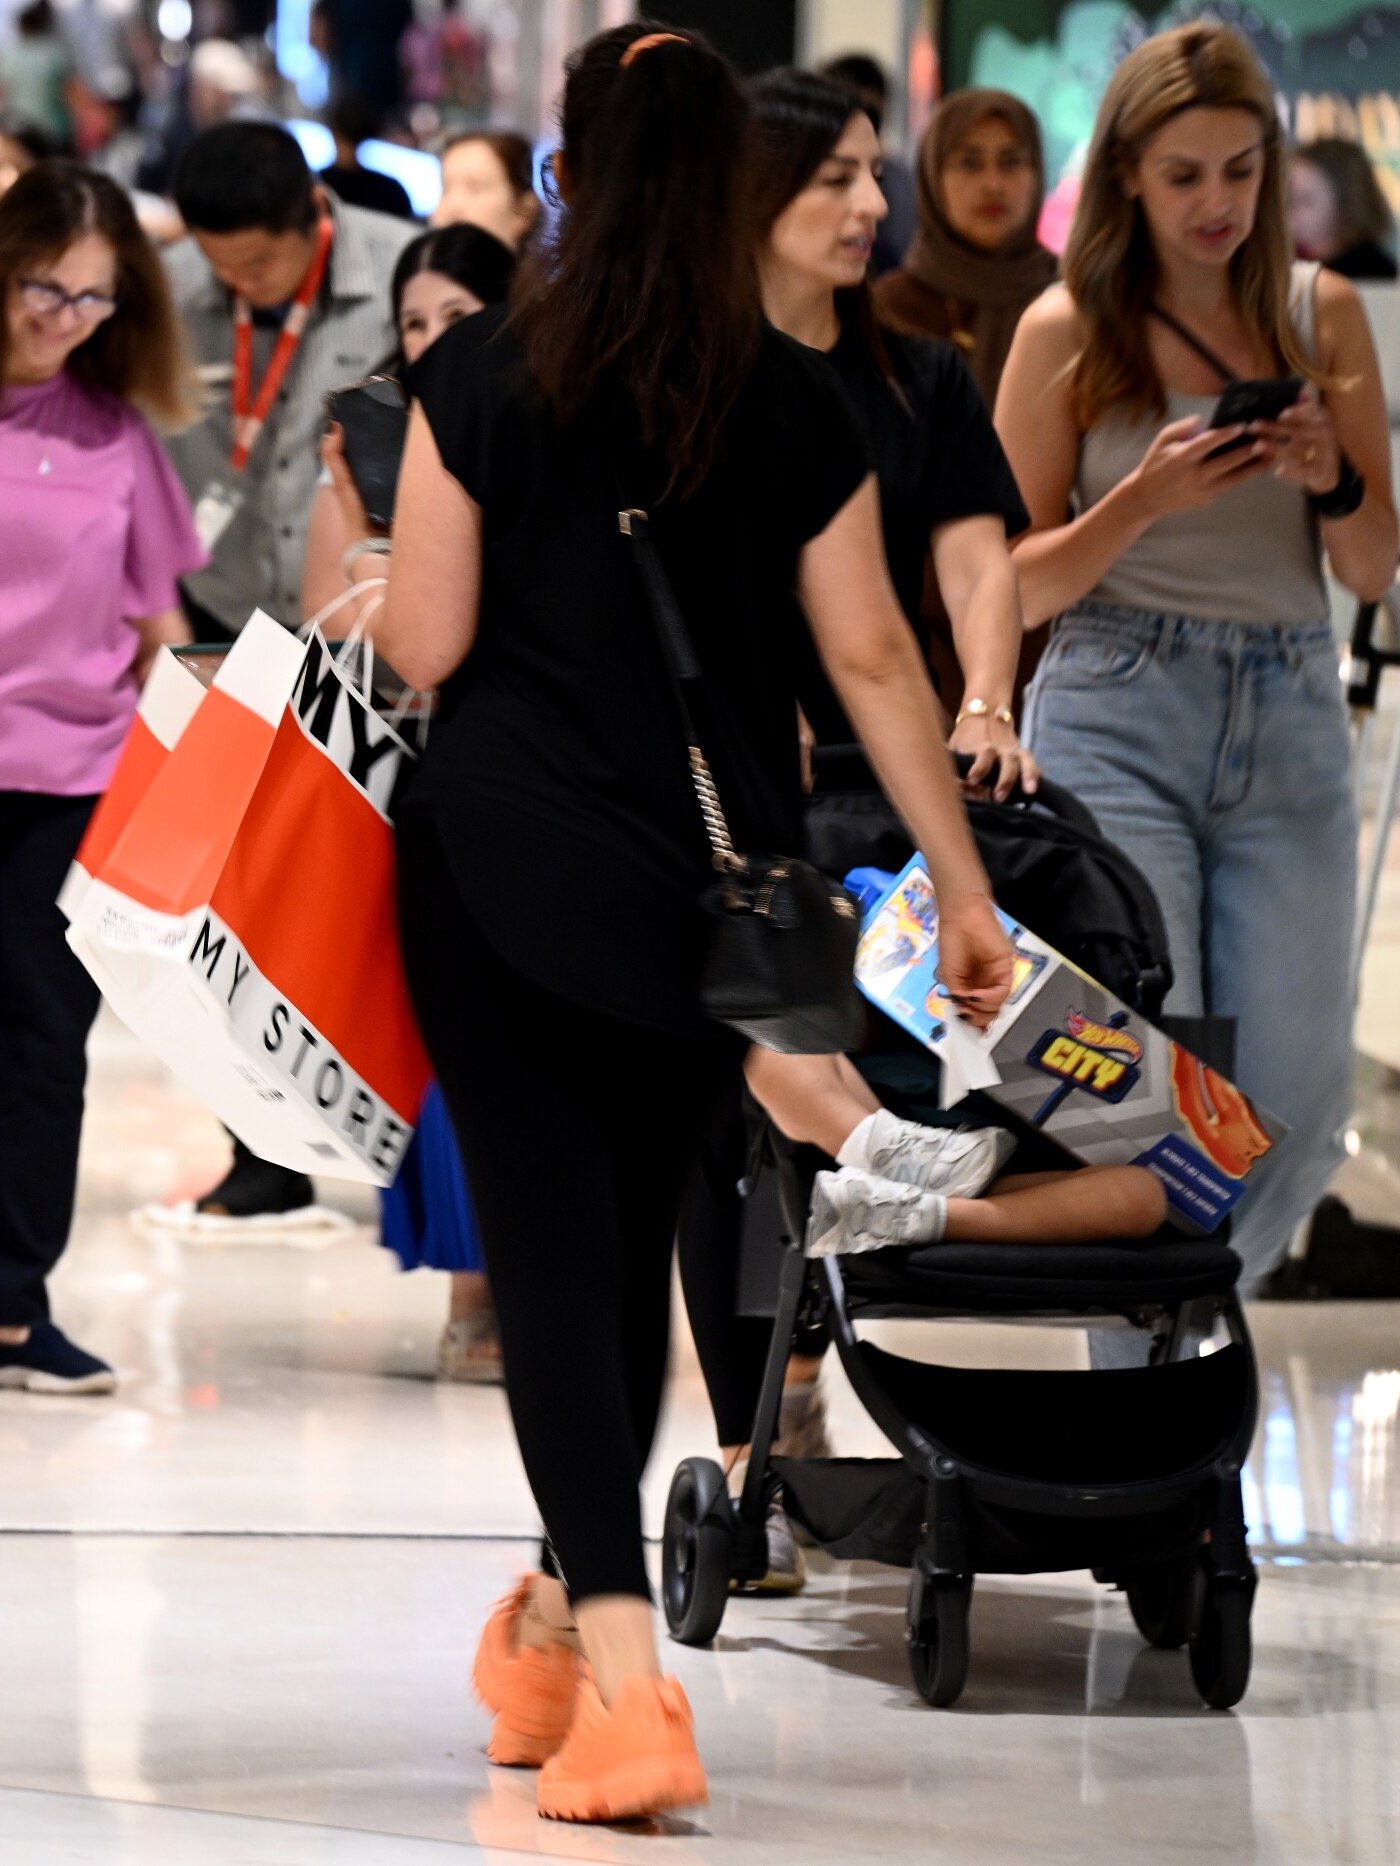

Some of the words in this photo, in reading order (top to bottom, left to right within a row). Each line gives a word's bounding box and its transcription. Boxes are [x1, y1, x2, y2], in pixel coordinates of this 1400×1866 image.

[188, 916, 250, 1005] MY
[264, 1002, 408, 1174] STORE
[1041, 1036, 1127, 1092] CITY
